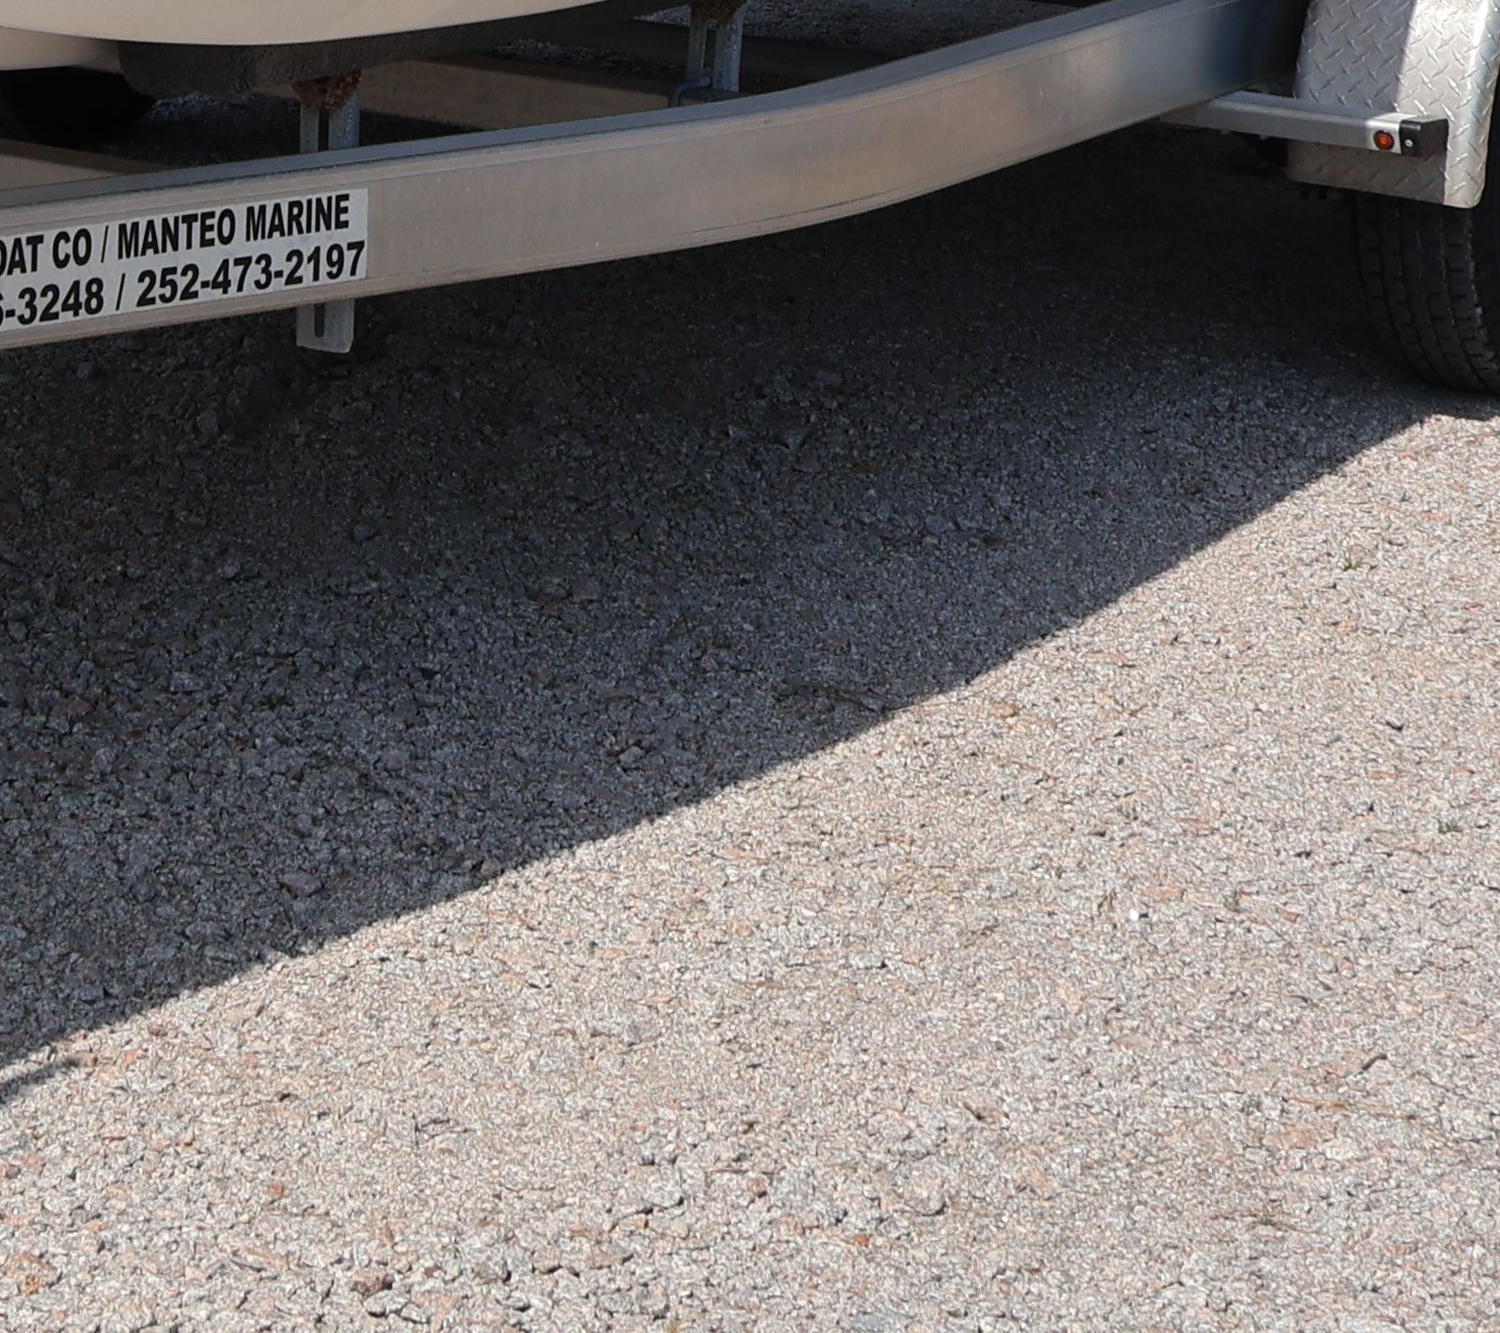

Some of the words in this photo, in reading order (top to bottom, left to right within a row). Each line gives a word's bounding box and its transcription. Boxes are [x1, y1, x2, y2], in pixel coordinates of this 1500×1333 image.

[52, 229, 93, 268] CO
[117, 208, 235, 260] MANTEO
[245, 193, 350, 243] MARINE
[136, 240, 366, 308] 252-473-2197
